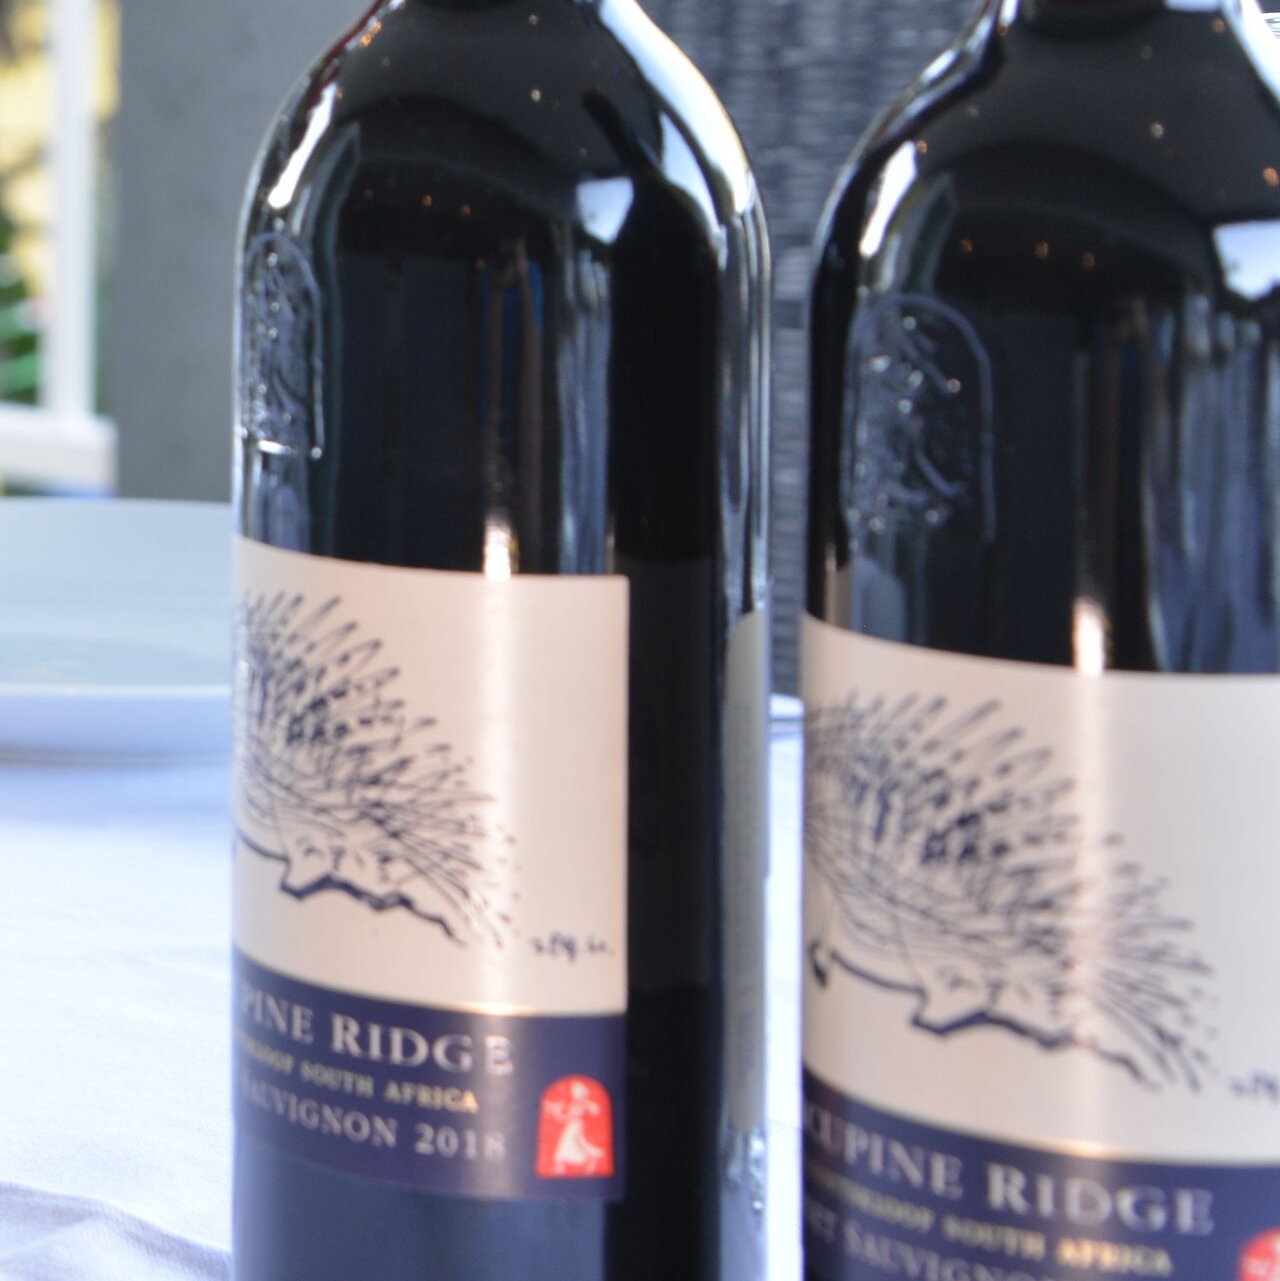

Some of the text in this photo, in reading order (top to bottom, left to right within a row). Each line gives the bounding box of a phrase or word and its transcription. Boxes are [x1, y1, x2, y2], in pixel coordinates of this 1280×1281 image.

[331, 1012, 514, 1075] RIDGE
[299, 1059, 479, 1114] SOUTH AFRICA
[414, 1122, 507, 1161] 2018
[986, 1161, 1215, 1237] RIDGE
[943, 1213, 1173, 1277] SOUTH AFRICA
